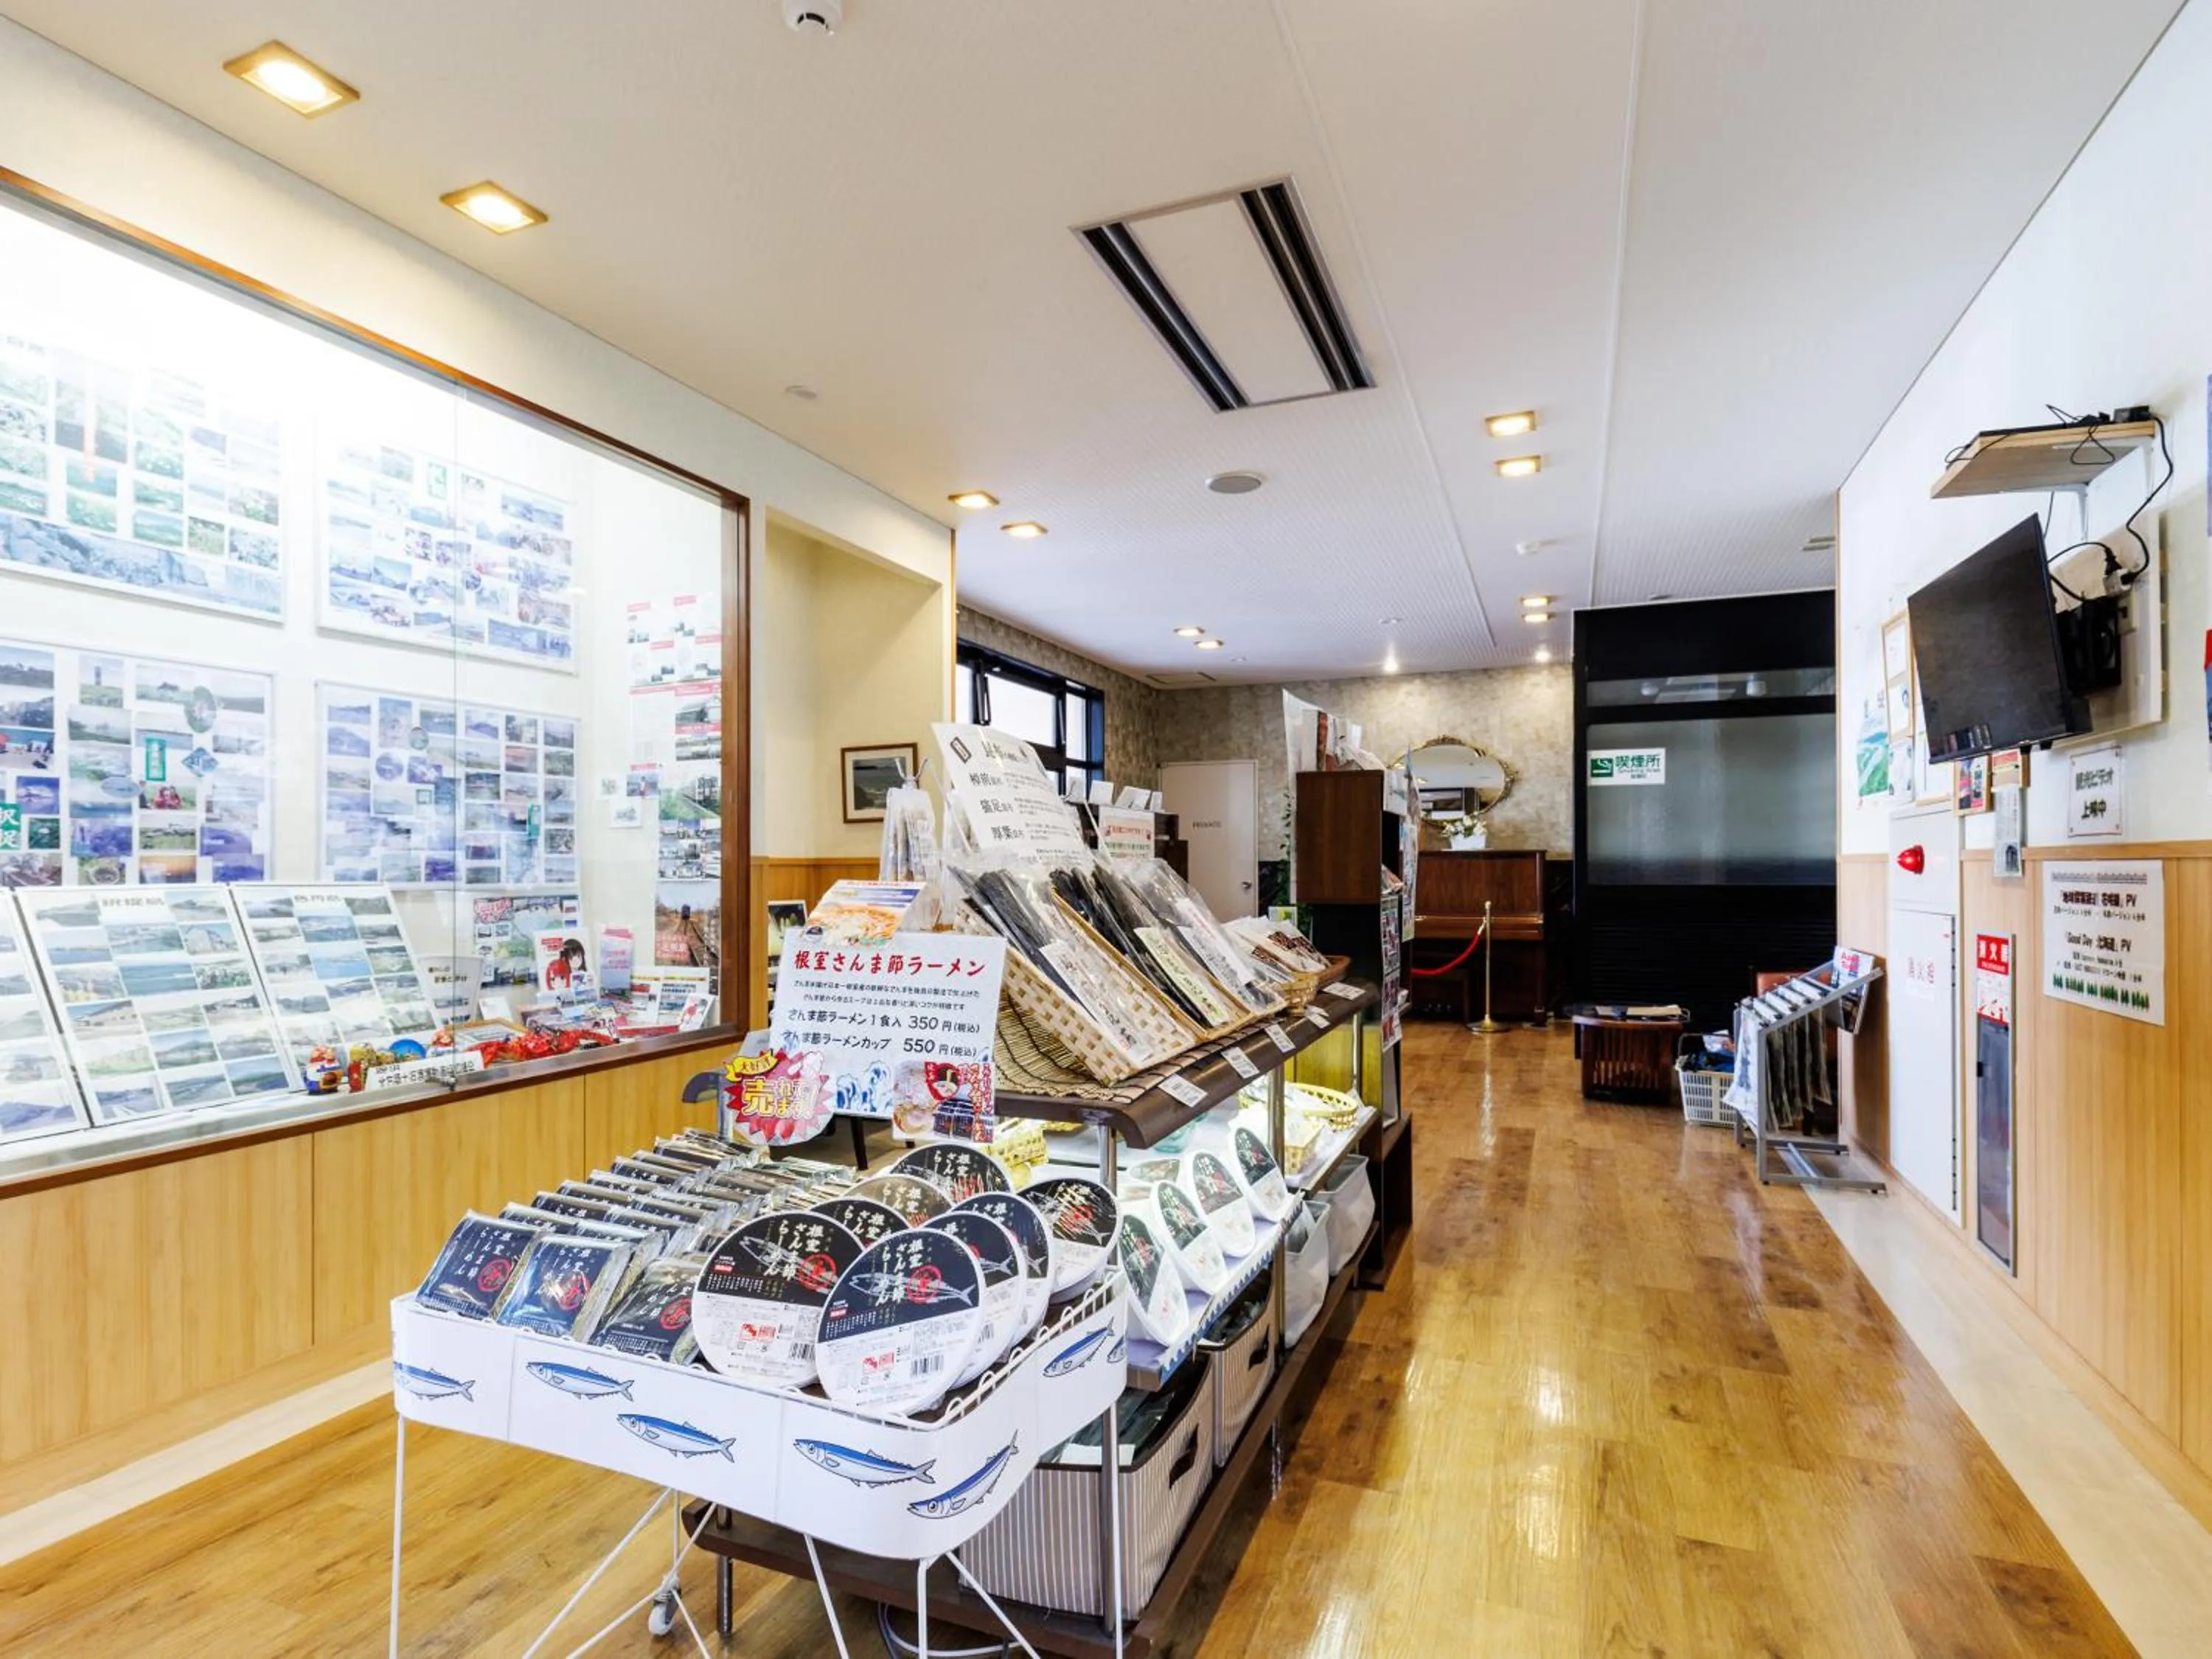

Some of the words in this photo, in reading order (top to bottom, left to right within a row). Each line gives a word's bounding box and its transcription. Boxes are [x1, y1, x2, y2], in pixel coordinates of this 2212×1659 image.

[1615, 754, 1660, 768] 喫煙所
[2081, 799, 2106, 819] 上映中
[1979, 939, 2008, 963] 消火器
[795, 950, 985, 977] 根室さんま節ラーメン
[908, 1015, 939, 1030] 350
[782, 1030, 891, 1050] さんま節ラーメンカップ
[903, 1037, 935, 1053] 550
[805, 1223, 824, 1252] 根室
[908, 1238, 923, 1269] 根室
